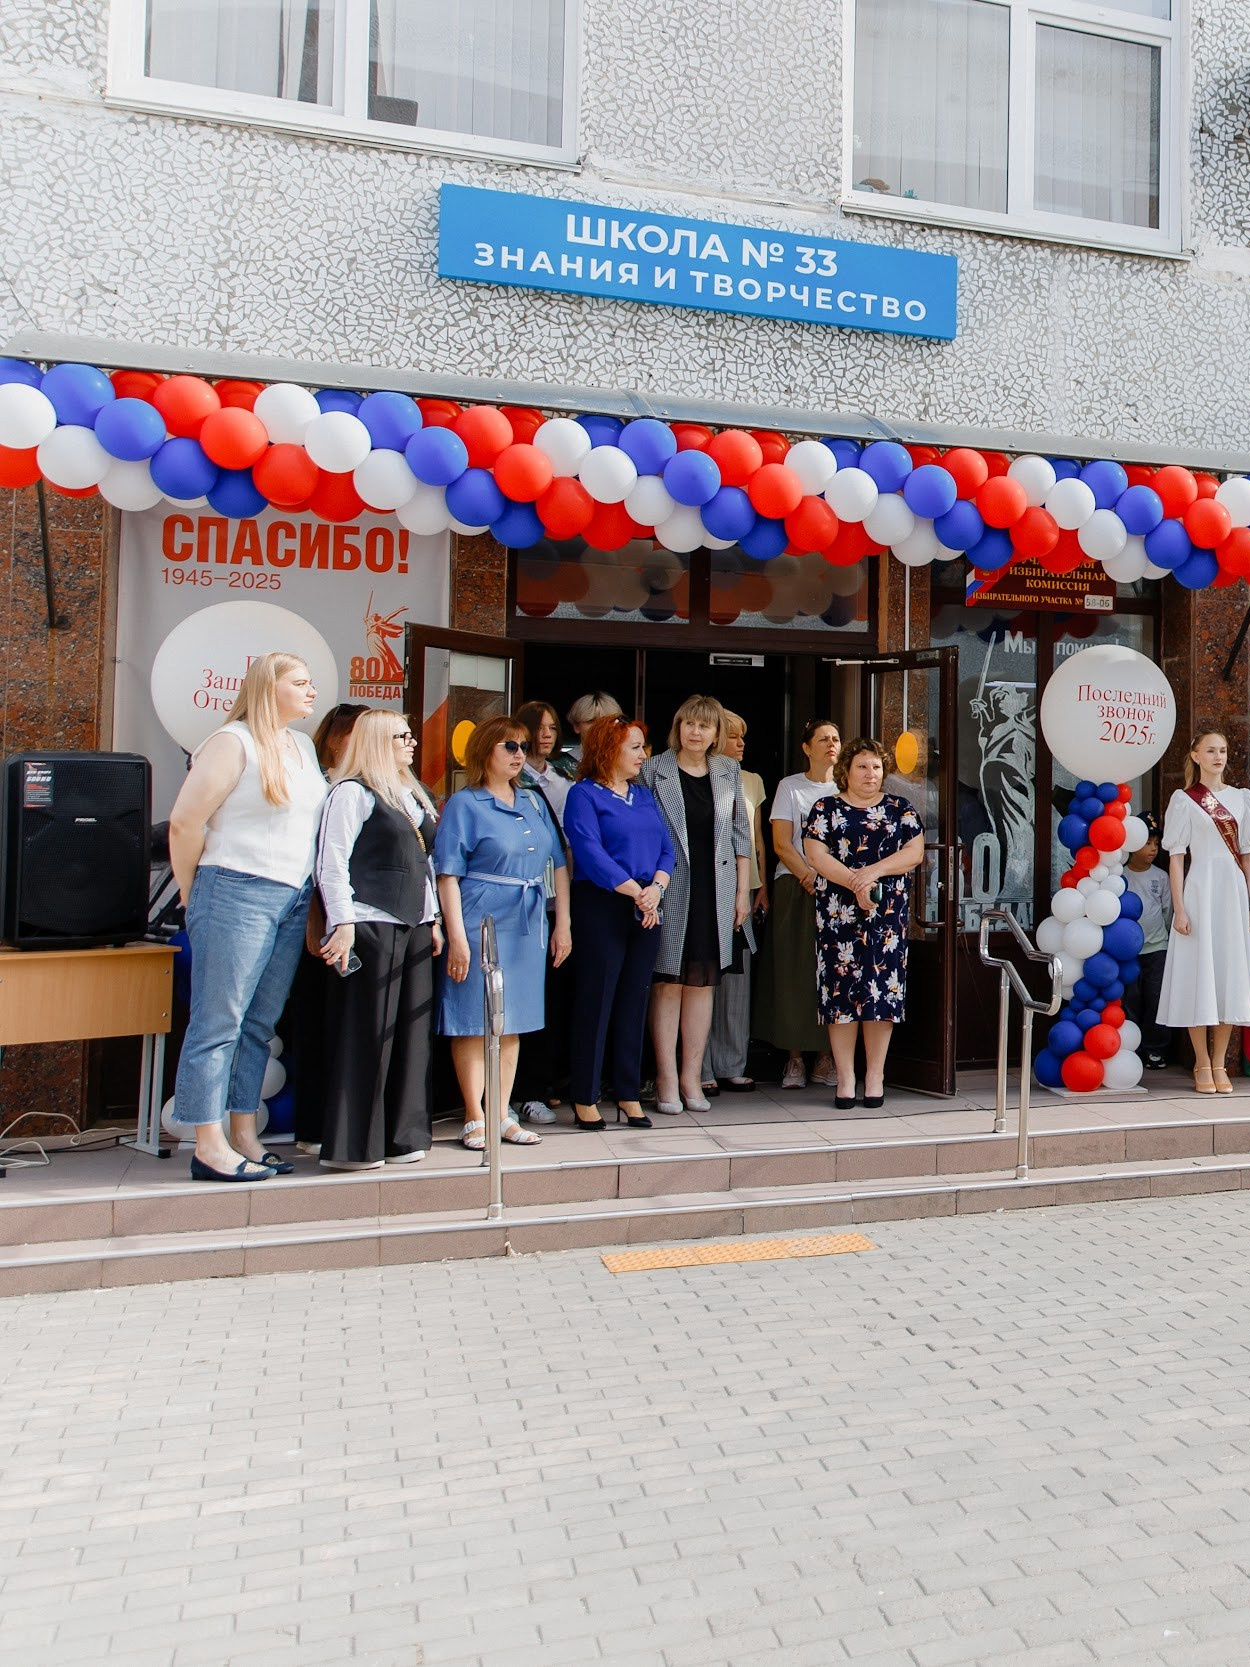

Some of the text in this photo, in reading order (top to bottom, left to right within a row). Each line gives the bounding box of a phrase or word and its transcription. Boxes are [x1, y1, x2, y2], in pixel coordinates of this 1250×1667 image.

[566, 214, 839, 277] ШКОЛА № 33
[473, 242, 927, 322] ЗНАНИЯ И ТВОРЧЕСТВО
[162, 513, 410, 574] СПАСИБО!
[1025, 578, 1091, 592] КОМИССИЯ
[972, 591, 1039, 603] ИЗБИРАТЕЛЬНОГО
[1040, 595, 1072, 605] УЧАСТКА
[350, 656, 381, 681] 80
[349, 684, 403, 700] ПОБЕДА
[1077, 684, 1168, 709] Последний
